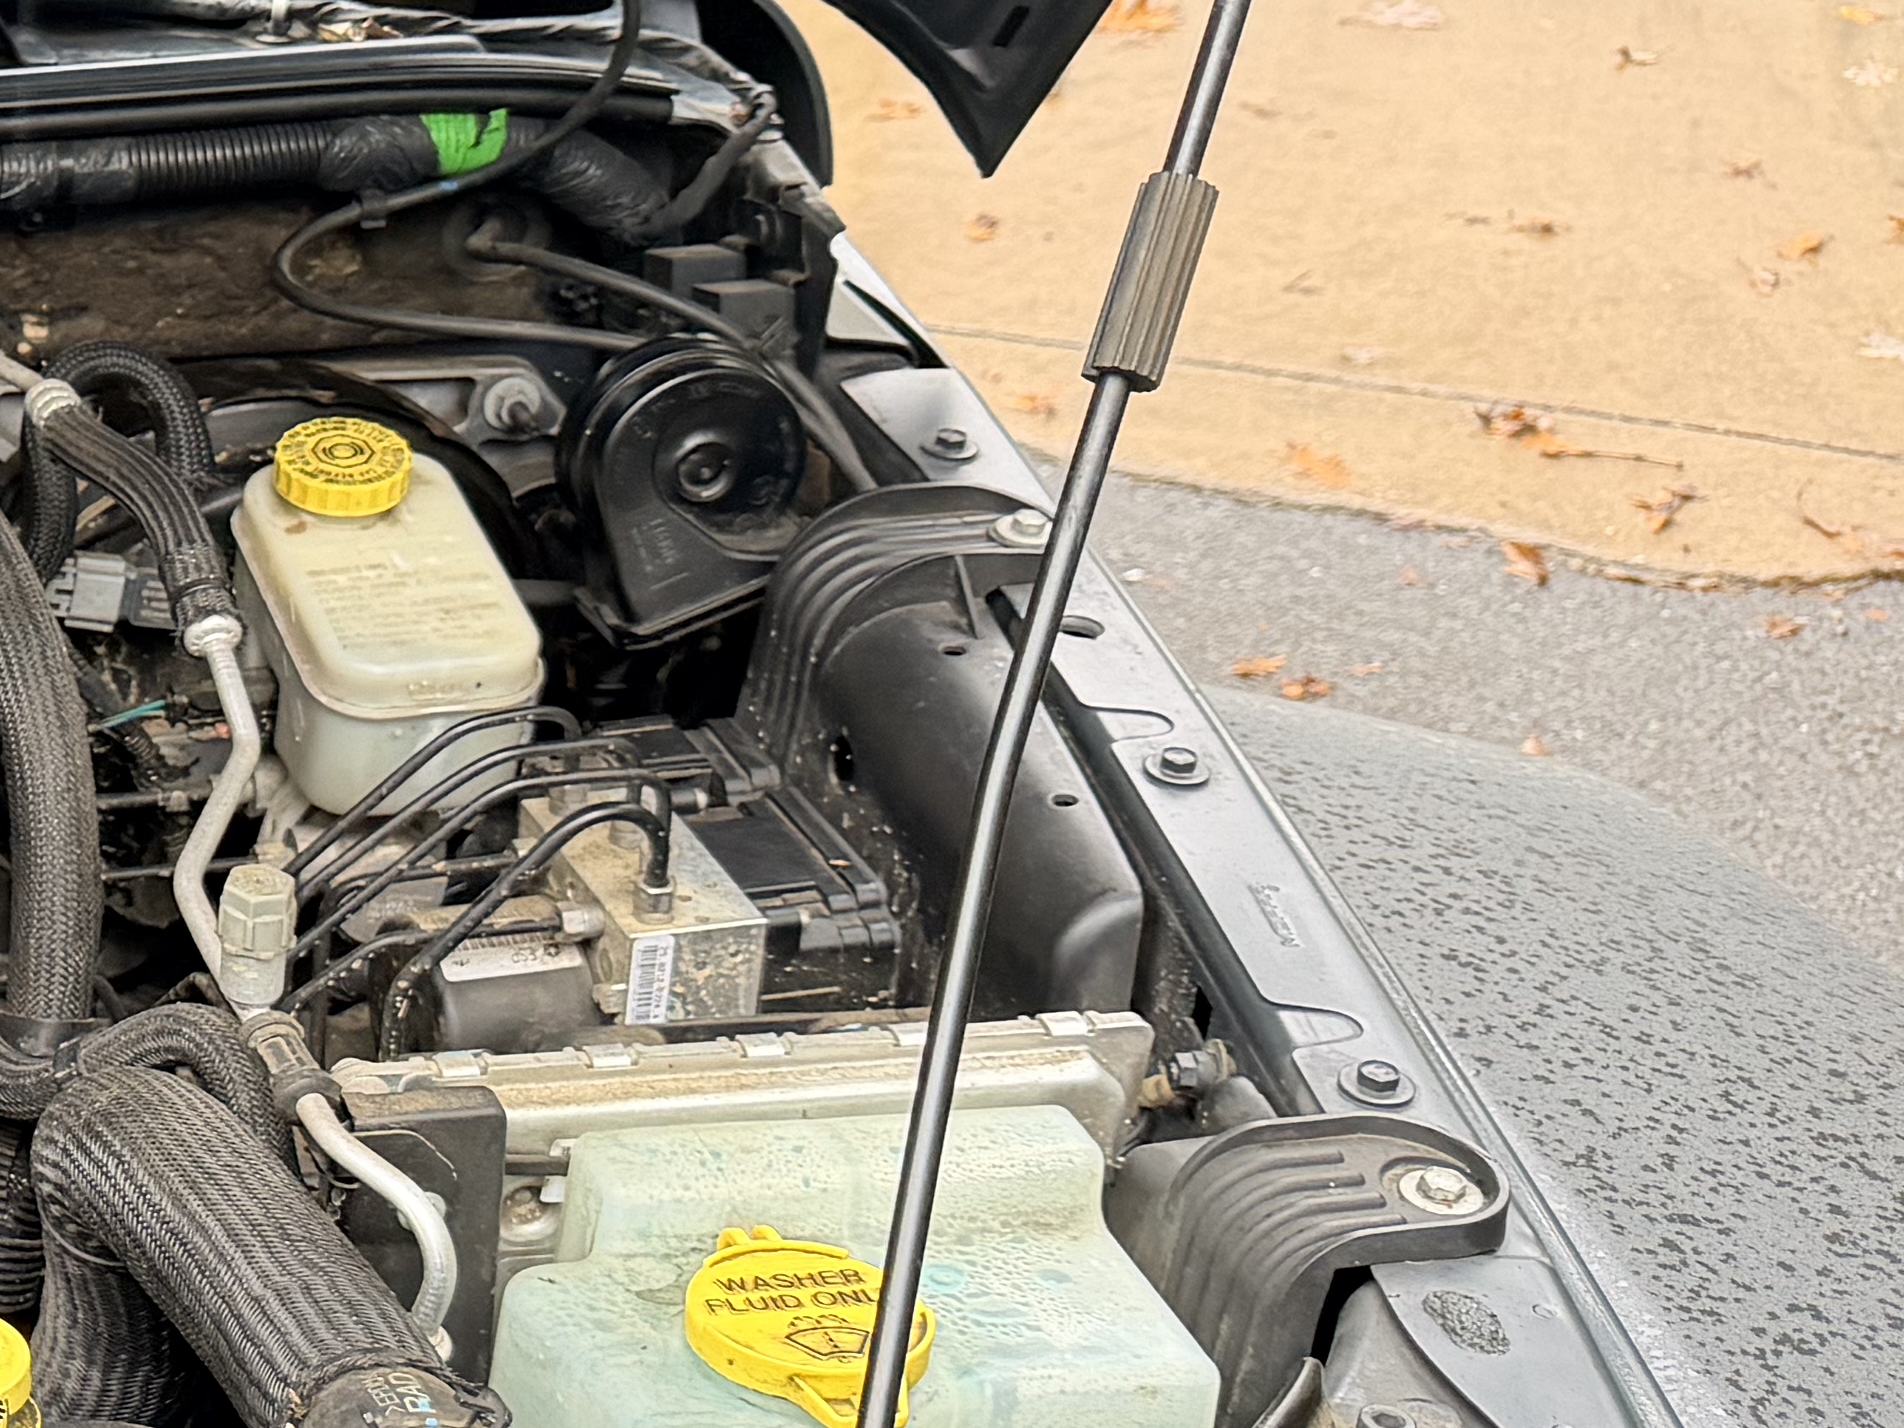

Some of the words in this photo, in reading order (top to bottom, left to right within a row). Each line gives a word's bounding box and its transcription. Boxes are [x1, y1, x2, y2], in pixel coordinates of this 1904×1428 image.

[713, 1269, 866, 1293] WASHER
[704, 1293, 804, 1315] FLUID
[810, 1287, 882, 1310] ONL
[388, 1373, 437, 1413] RAD
